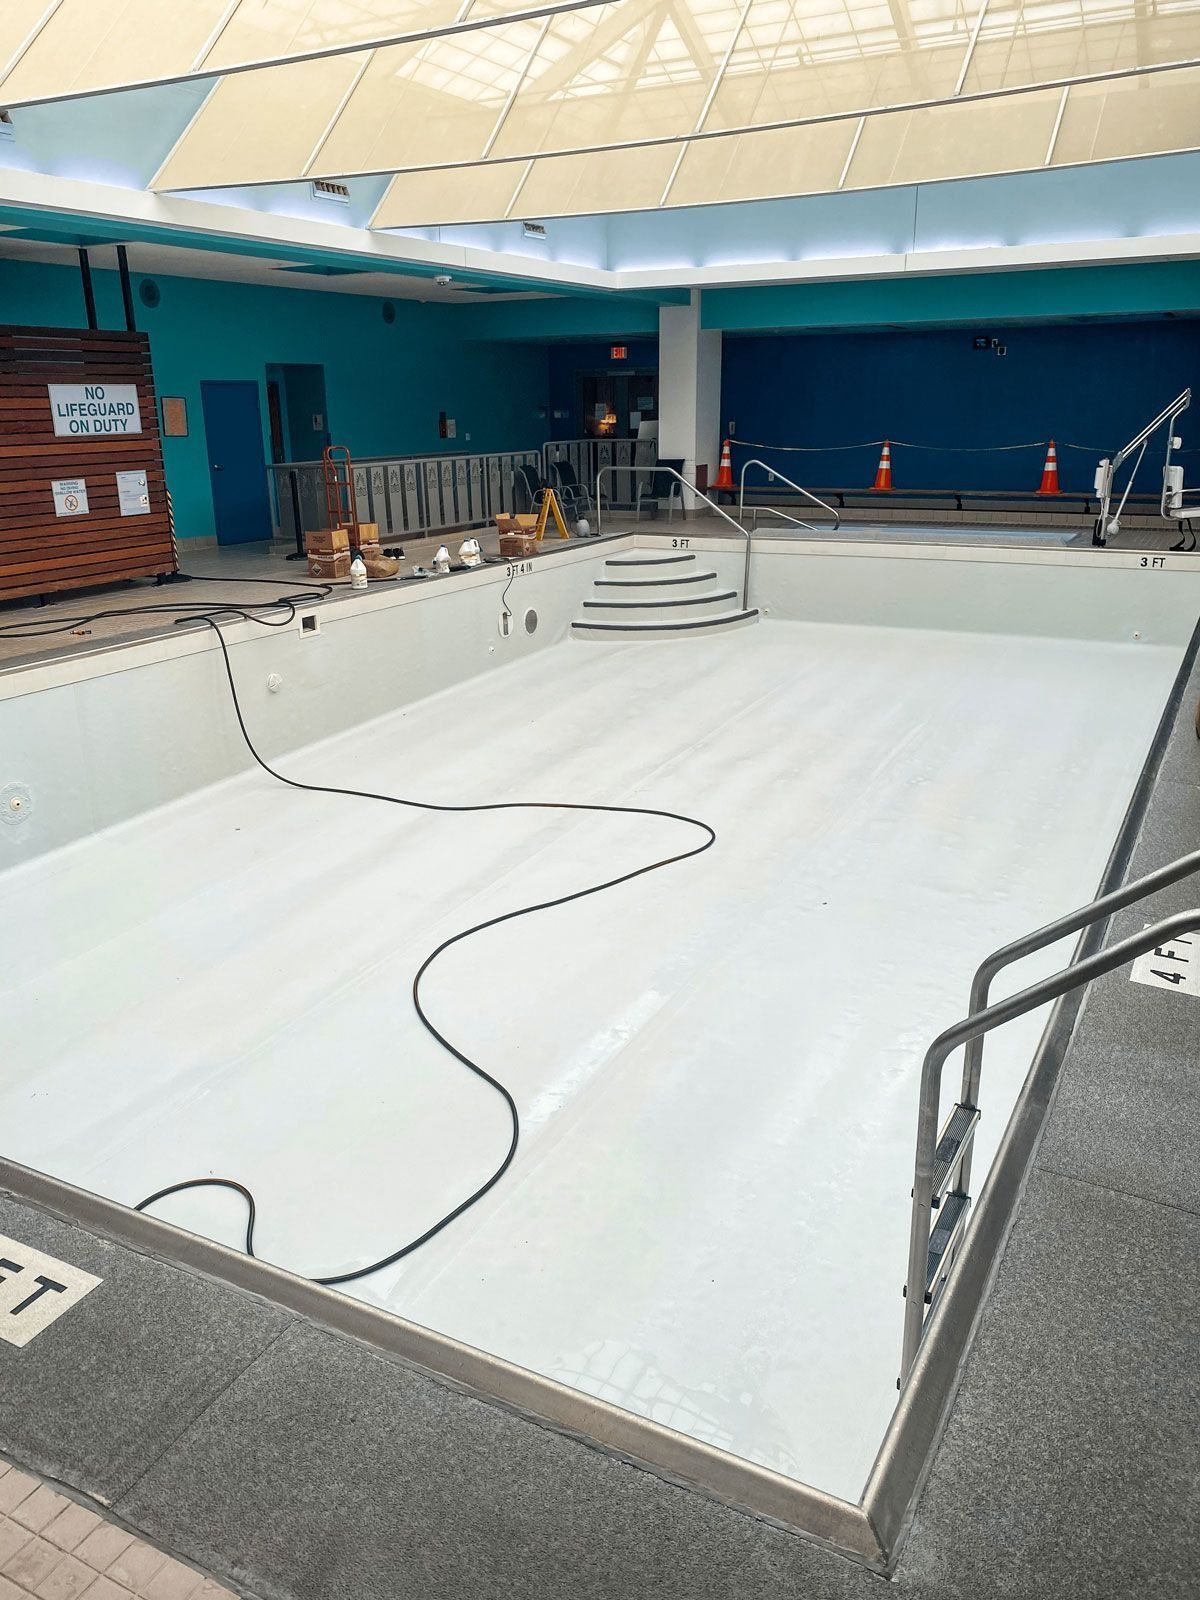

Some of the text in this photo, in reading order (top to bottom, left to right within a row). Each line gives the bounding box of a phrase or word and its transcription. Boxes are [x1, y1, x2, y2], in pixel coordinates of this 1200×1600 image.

[84, 386, 105, 400] NO
[57, 402, 135, 417] LIFEGUARD
[69, 418, 128, 434] ON DUTY
[672, 539, 690, 549] 3 FT
[506, 566, 511, 577] 3
[520, 563, 525, 573] 4
[526, 562, 533, 572] IN
[1140, 557, 1166, 568] 3 FT
[1150, 969, 1186, 984] 4
